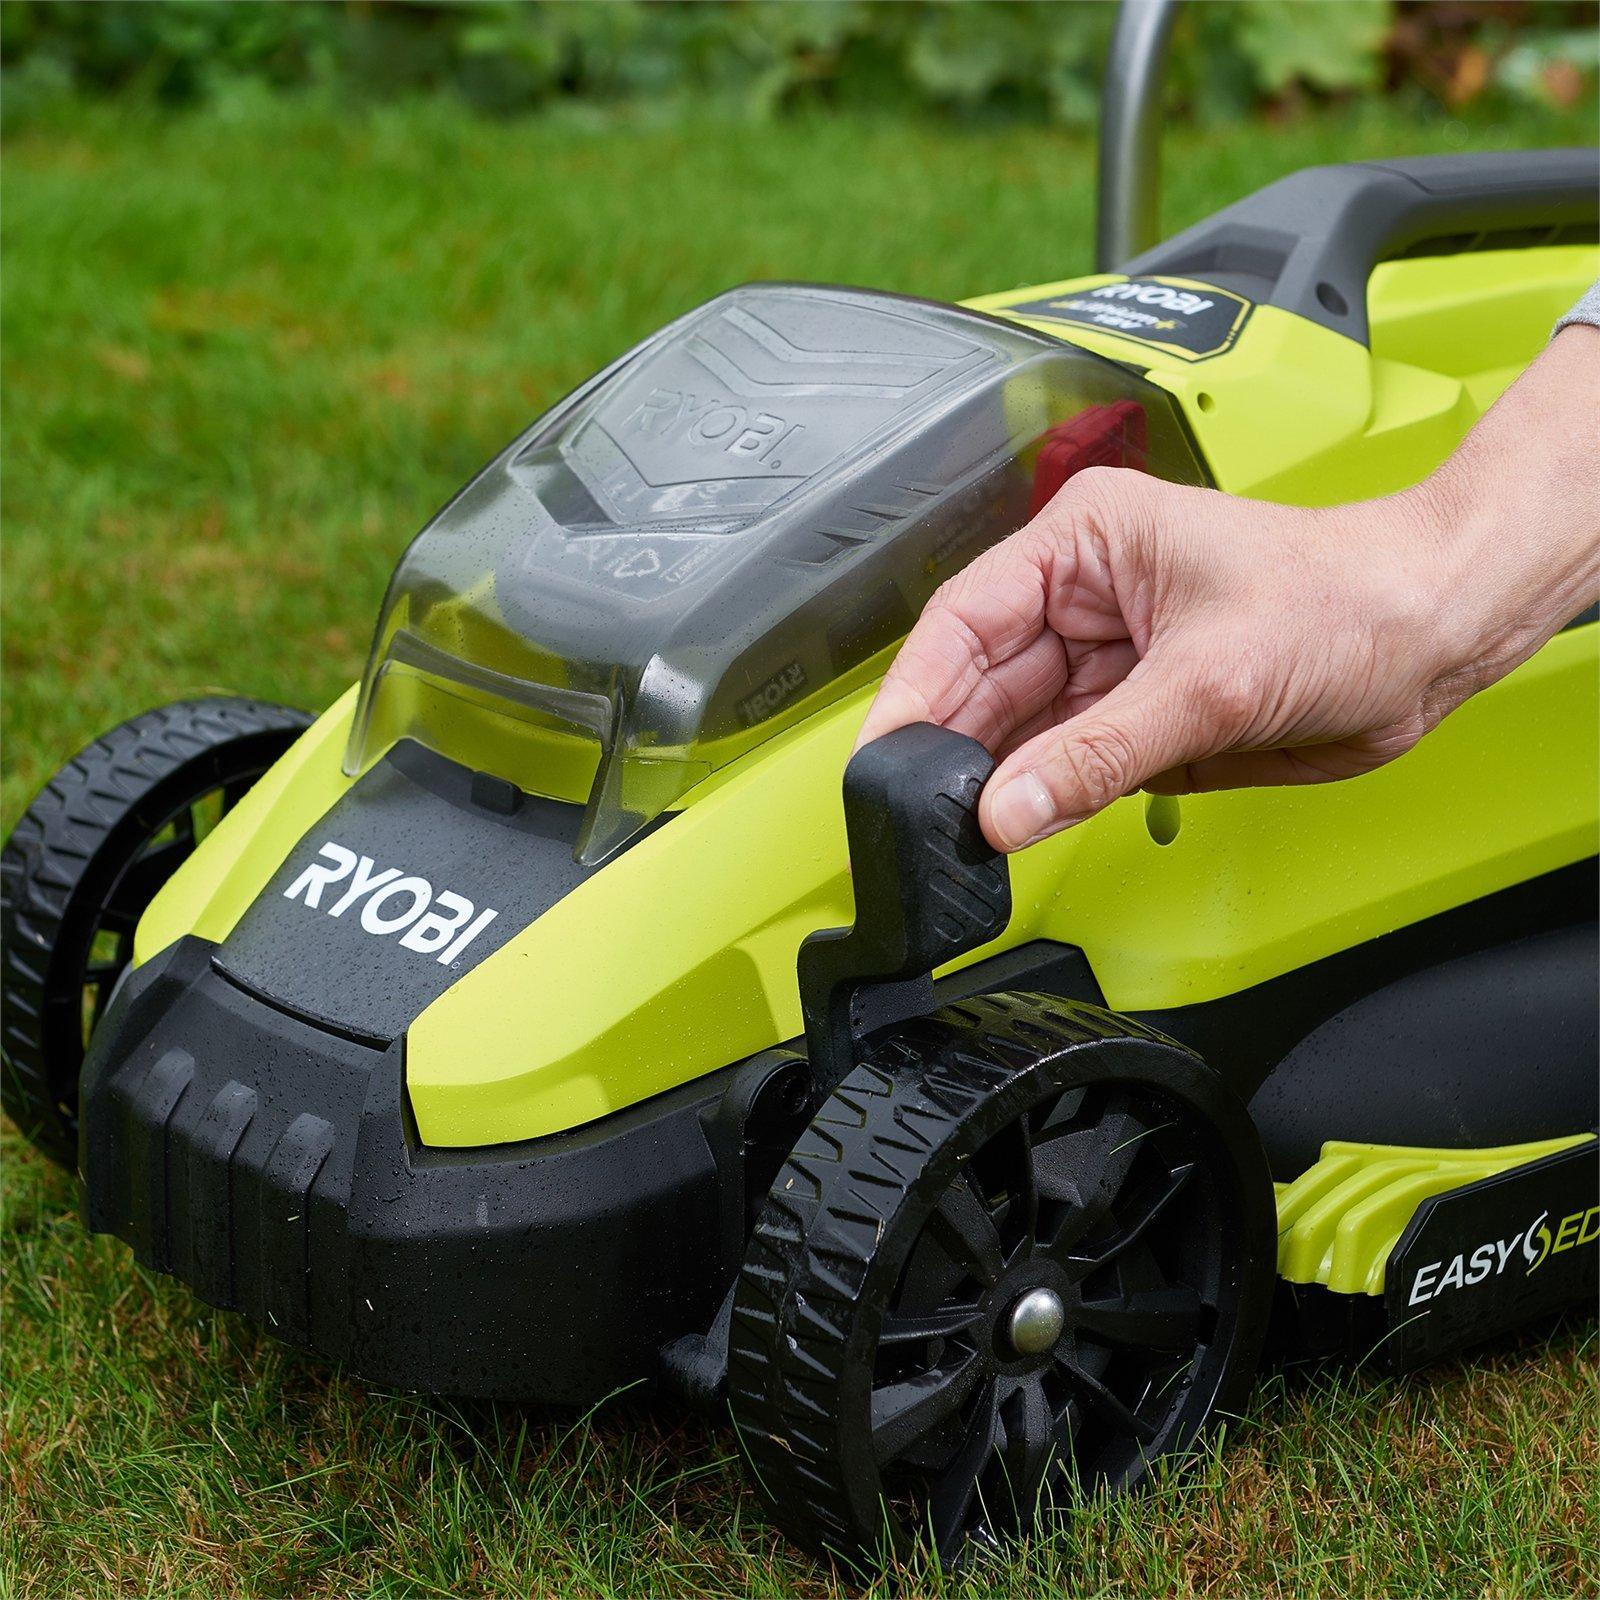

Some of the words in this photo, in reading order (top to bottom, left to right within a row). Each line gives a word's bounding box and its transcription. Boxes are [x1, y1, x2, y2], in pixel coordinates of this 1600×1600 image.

[1090, 284, 1215, 315] RYOBI
[620, 388, 806, 466] RYOBI
[283, 841, 499, 966] RYOBI
[1408, 1232, 1524, 1306] EASY
